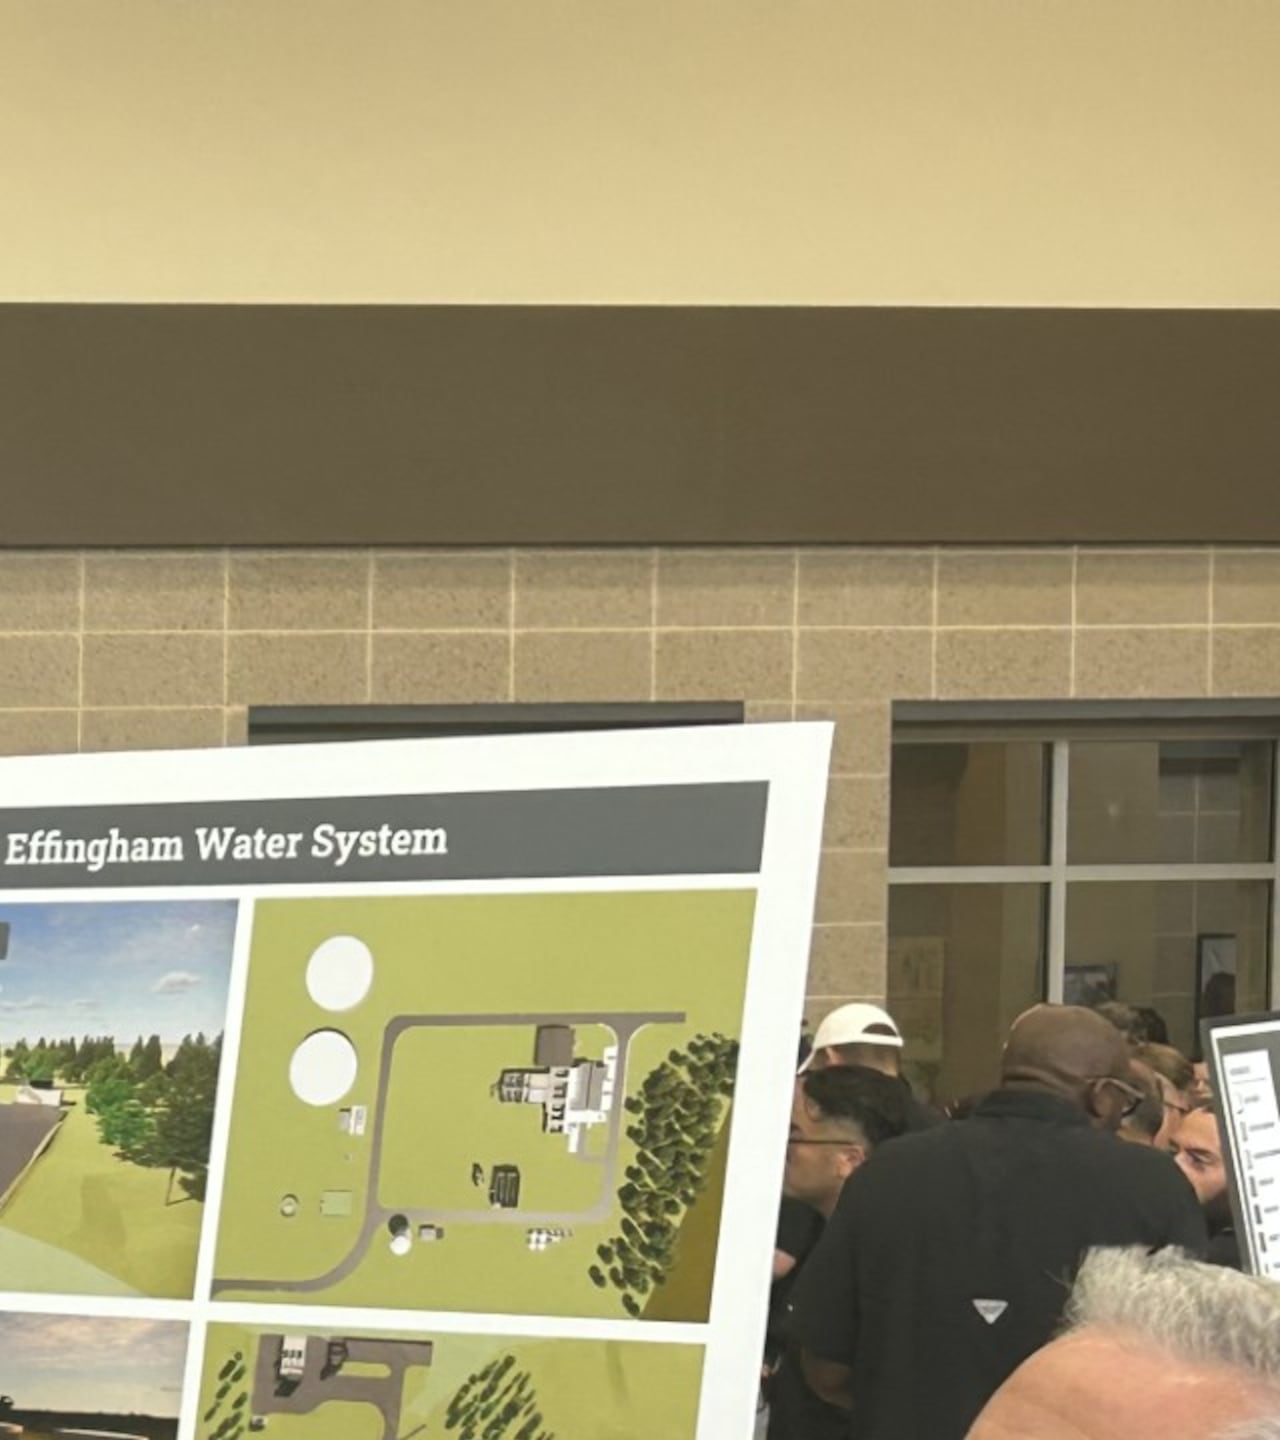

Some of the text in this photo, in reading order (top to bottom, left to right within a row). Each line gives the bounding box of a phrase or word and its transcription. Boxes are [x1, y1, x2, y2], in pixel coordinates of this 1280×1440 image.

[4, 829, 185, 872] Effingham
[196, 826, 303, 860] Water
[312, 823, 449, 866] System
